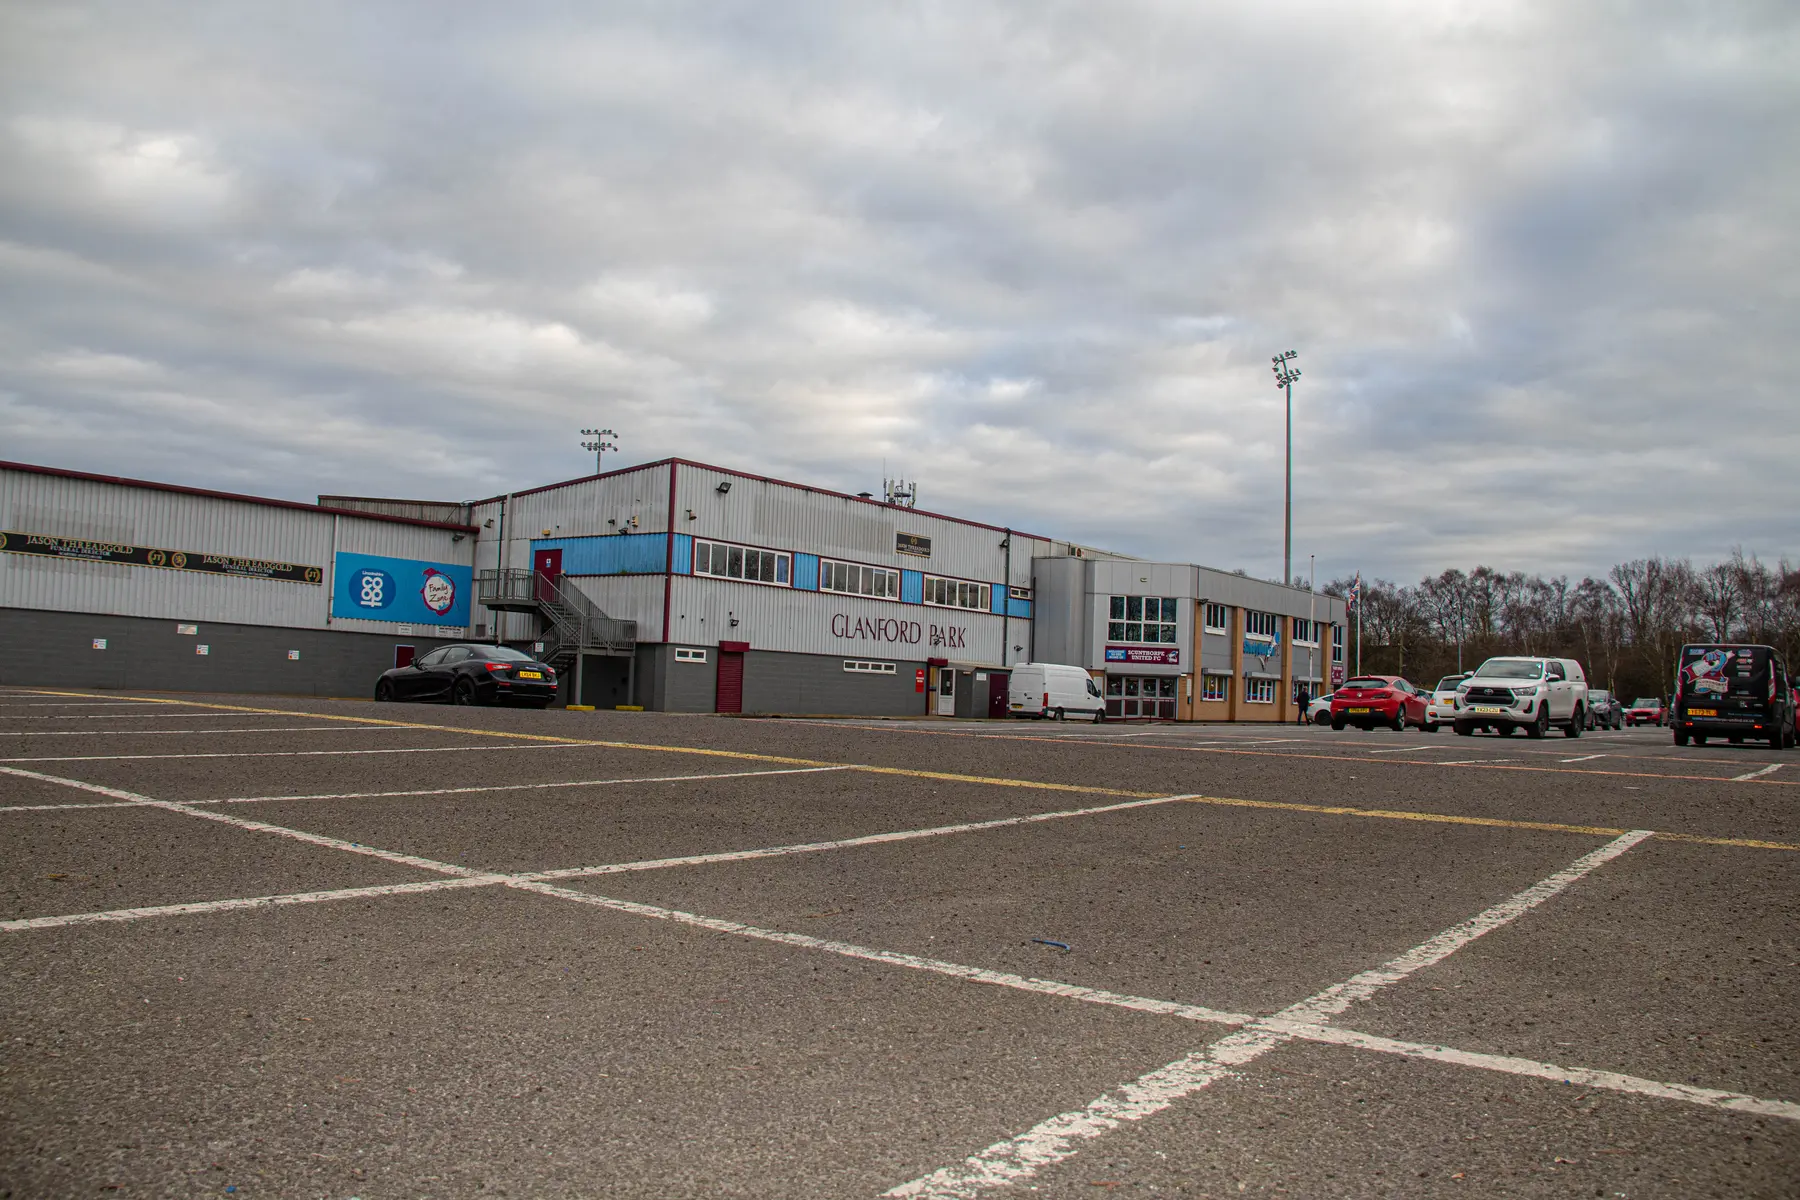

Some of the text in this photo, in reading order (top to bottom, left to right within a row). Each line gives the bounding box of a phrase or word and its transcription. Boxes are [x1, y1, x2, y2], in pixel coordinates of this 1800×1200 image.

[27, 535, 133, 555] JASON THREADGOLD
[50, 545, 79, 554] FUNERAL
[203, 555, 229, 565] JASON
[232, 557, 292, 573] THREADGOLD
[428, 583, 449, 595] Family
[429, 594, 448, 602] Zone
[832, 613, 967, 648] GLANFORD PARK
